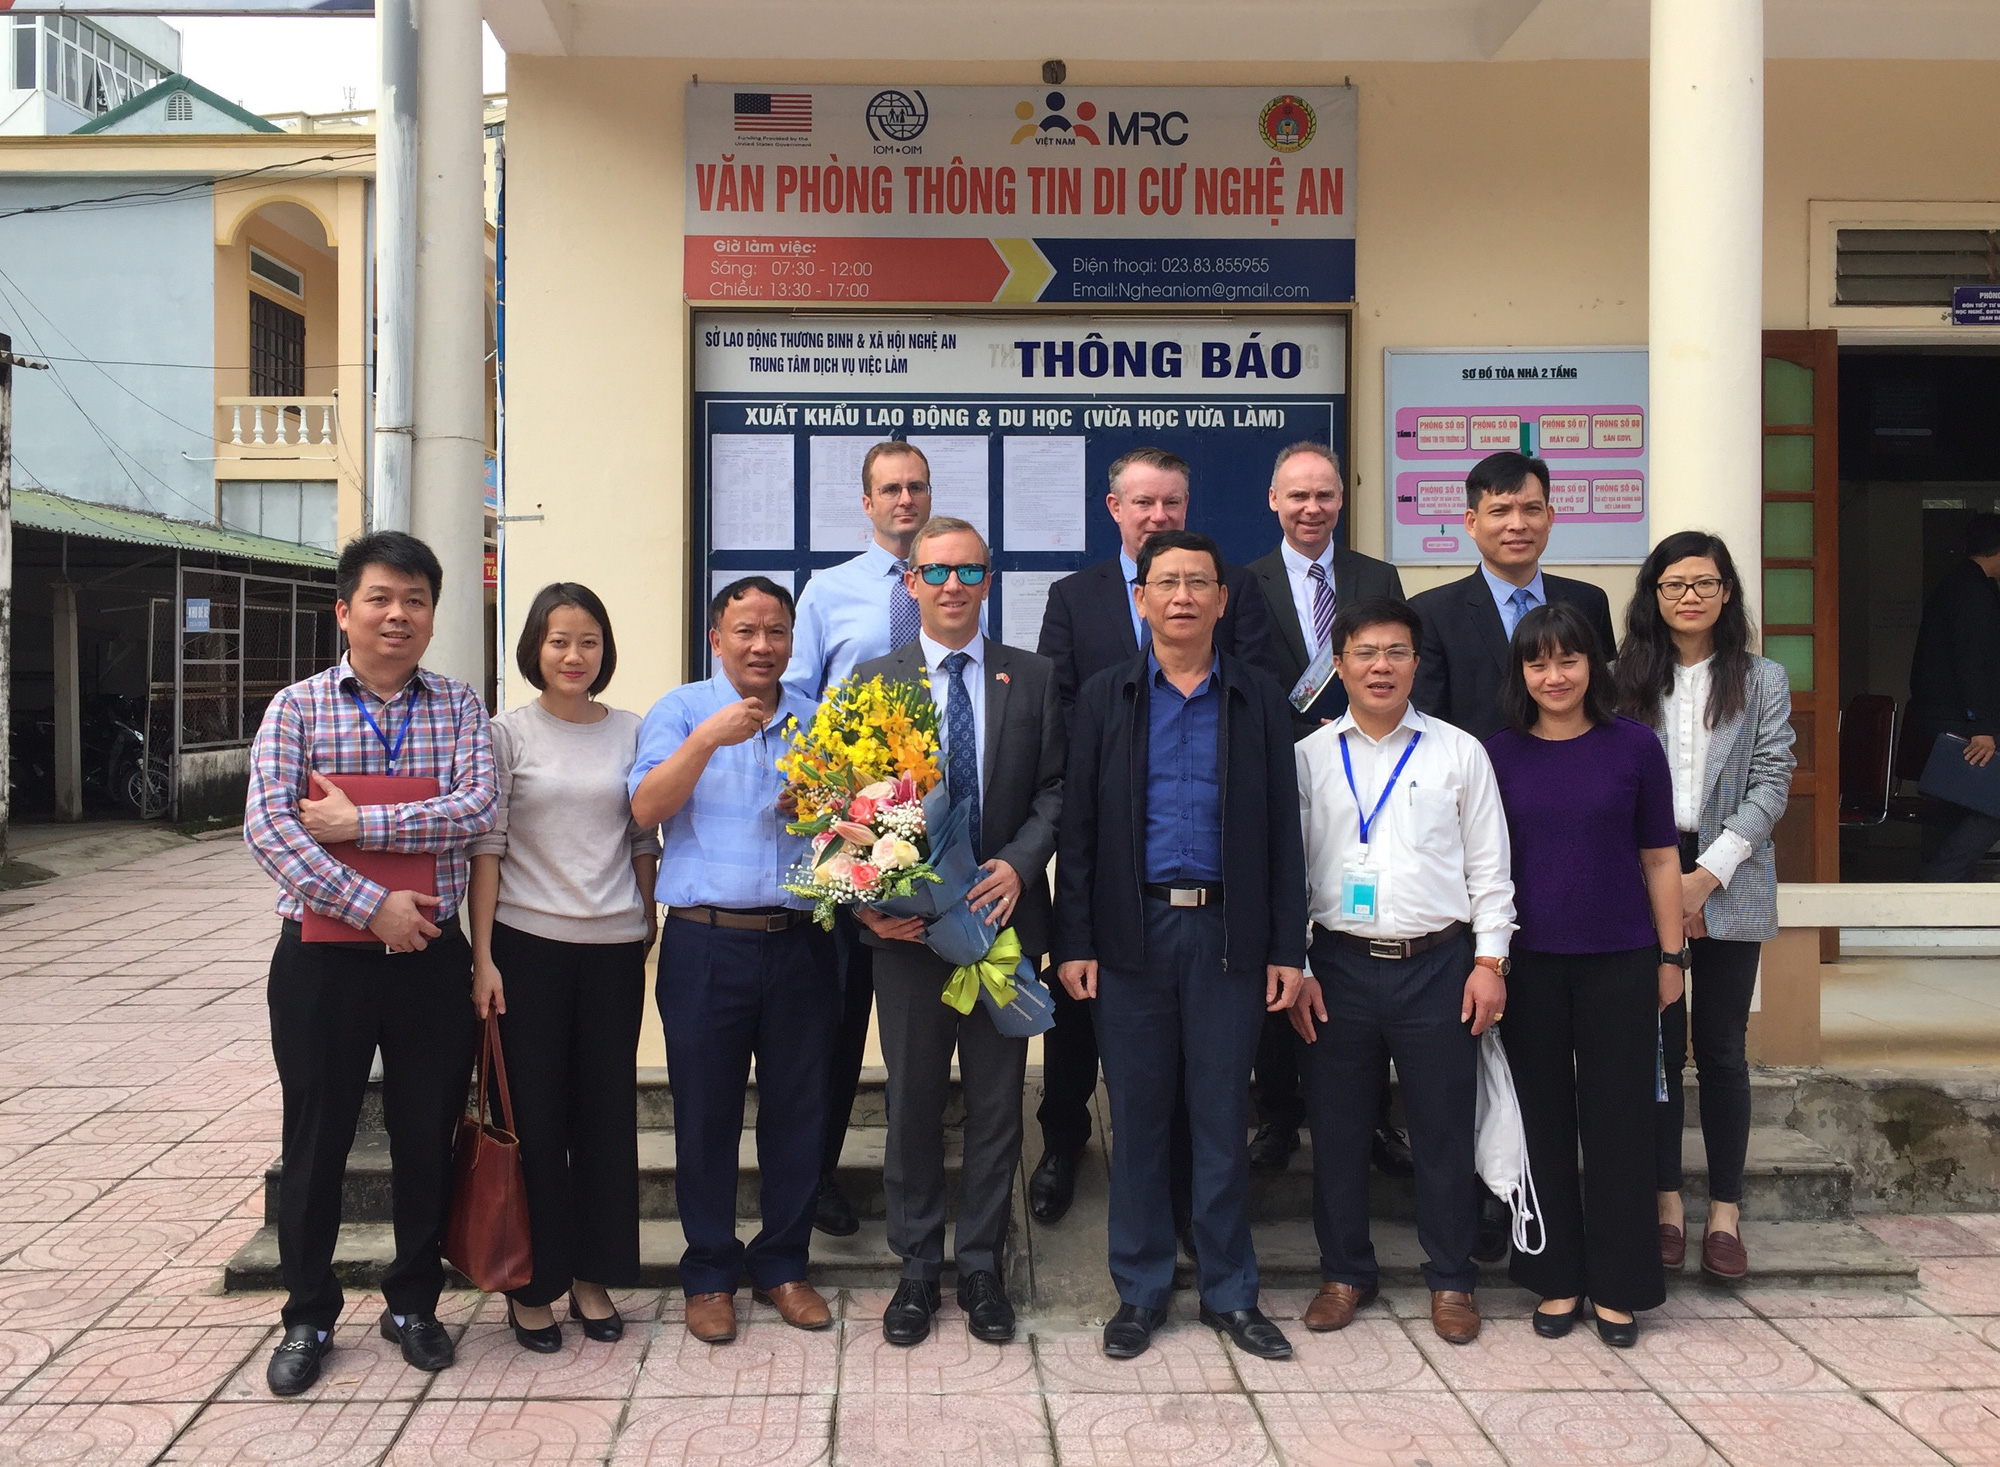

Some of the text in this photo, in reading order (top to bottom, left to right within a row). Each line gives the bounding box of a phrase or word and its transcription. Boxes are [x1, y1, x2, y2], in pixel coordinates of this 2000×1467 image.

[1108, 111, 1188, 145] MRC
[873, 146, 922, 154] IOM OIM
[1035, 137, 1054, 147] VIỆT
[696, 153, 1343, 226] VĂN PHÒNG THÔNG TIN DI CƯ NGHỆ AN
[714, 240, 816, 256] Giờ làm việc:
[711, 261, 757, 278] Sáng:
[772, 262, 814, 276] 07:30
[832, 262, 872, 276] 12:00
[1073, 258, 1269, 276] Điện thoại: 023.83.855955
[710, 279, 763, 296] Chiều:
[770, 282, 811, 296] 13:30
[828, 284, 869, 297] 17:00
[706, 326, 956, 352] SỞ LAO ĐỘNG THƯƠNG BINH & XÃ HỘI NGHỆ AN
[1014, 332, 1182, 378] THÔNG
[1202, 332, 1301, 378] BÁO
[750, 354, 908, 376] TRUNG TÂM DỊCH VỤ VIỆC LÀM
[1462, 368, 1476, 378] SƠ
[1495, 366, 1514, 378] TÒA
[1518, 366, 1538, 378] NHÀ
[1542, 368, 1548, 378] 2
[745, 403, 1285, 431] XUẤT KHẨU LAO ĐỘNG & DU HỌC (VỪA HỌC VỪA LÀM)
[1456, 421, 1464, 429] 05
[1578, 420, 1586, 428] 07
